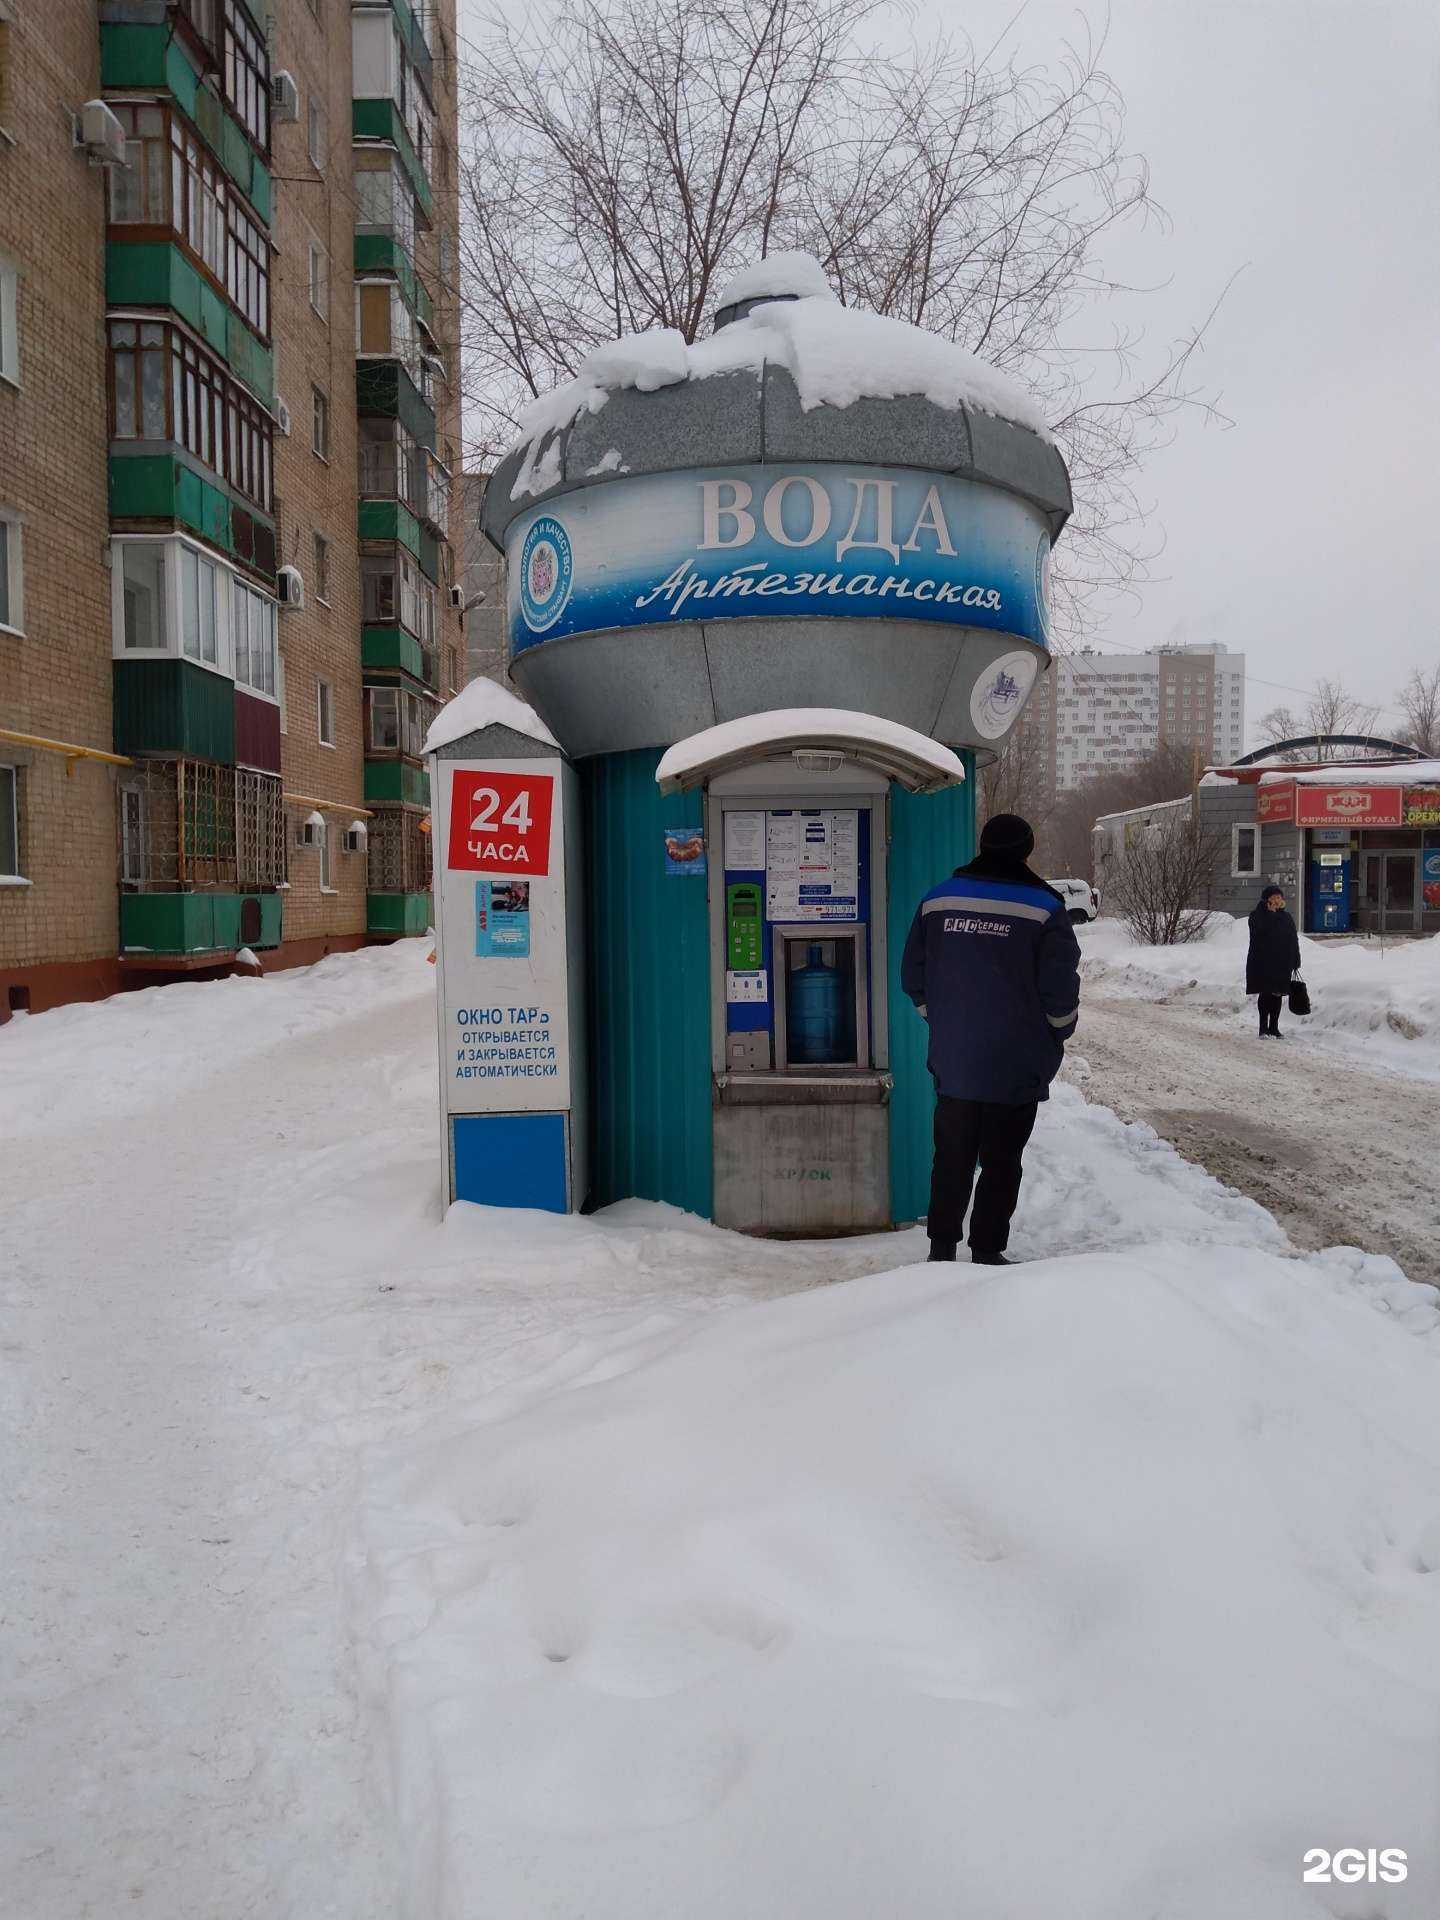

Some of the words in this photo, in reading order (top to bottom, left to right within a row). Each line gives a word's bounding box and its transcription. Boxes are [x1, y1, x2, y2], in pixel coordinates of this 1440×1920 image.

[697, 476, 958, 564] ВОДА
[545, 523, 571, 576] КАЧЕСТВО
[635, 558, 1002, 615] Артезианская
[469, 787, 533, 836] 24
[1301, 815, 1363, 823] ФИРМЕННЫЙ
[467, 840, 530, 862] ЧАСА
[457, 1008, 503, 1025] ОКНО
[462, 1030, 550, 1044] ОТКРЫВАЕТСЯ
[457, 1049, 465, 1061] И
[468, 1047, 556, 1061] ЗАКРЫВАЕТСЯ
[456, 1065, 557, 1079] АВТОМАТИЧЕСКИ
